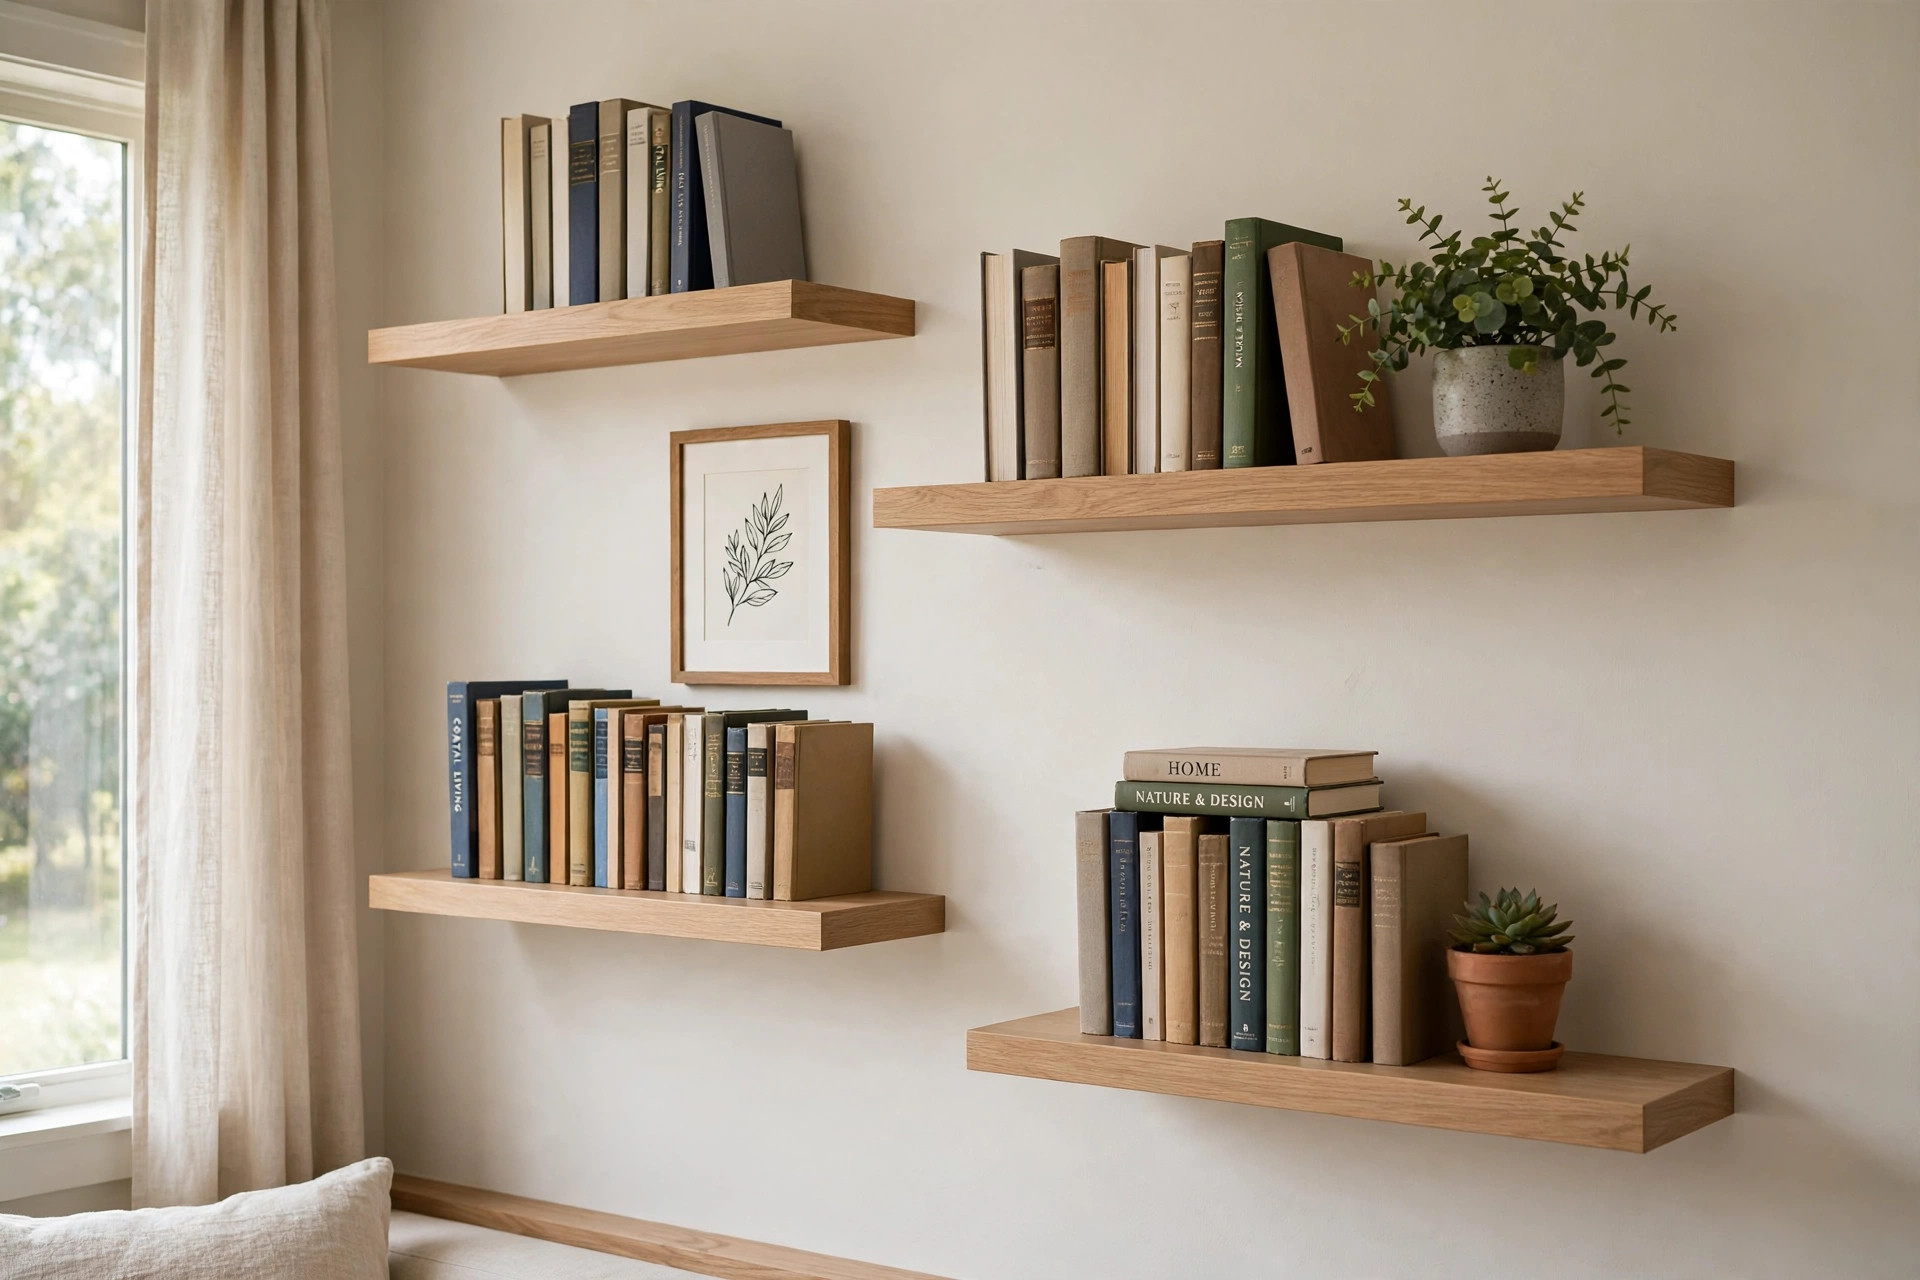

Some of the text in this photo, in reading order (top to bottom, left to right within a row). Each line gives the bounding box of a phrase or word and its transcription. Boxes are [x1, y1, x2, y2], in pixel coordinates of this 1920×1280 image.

[1167, 760, 1222, 777] HOME
[453, 771, 463, 813] LIVING
[1136, 790, 1265, 809] NATURE & DESIGN
[1238, 846, 1251, 1002] NATURE & DESIGN
